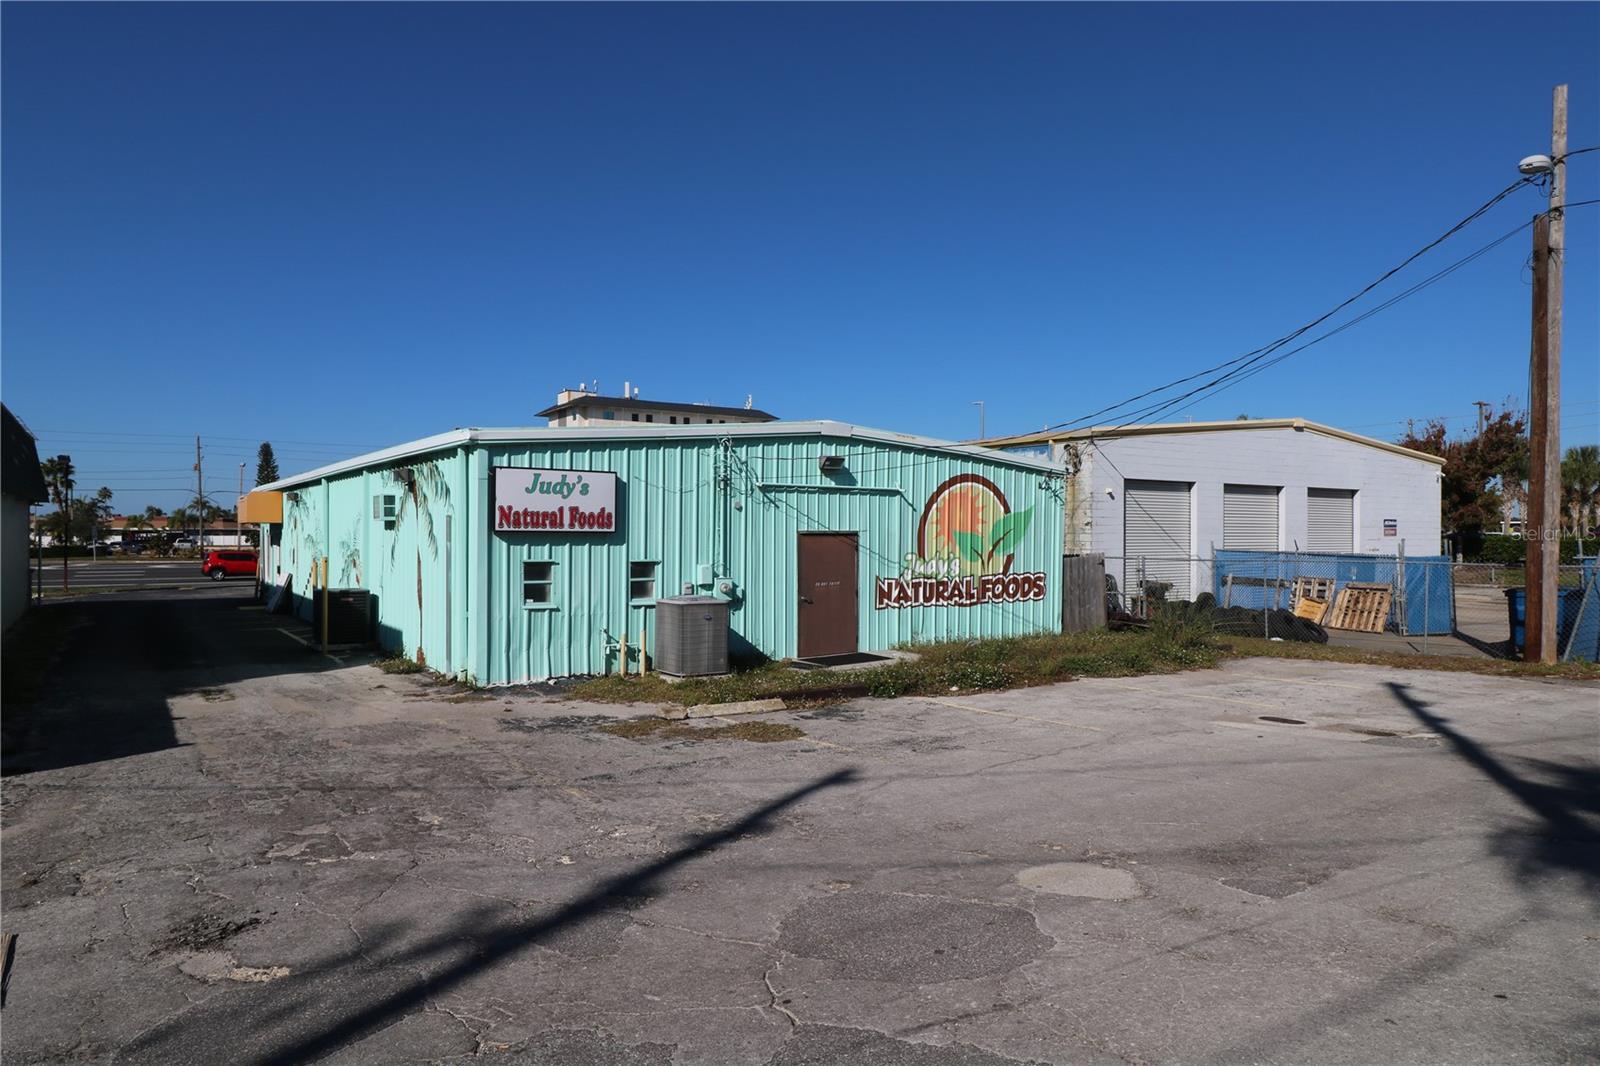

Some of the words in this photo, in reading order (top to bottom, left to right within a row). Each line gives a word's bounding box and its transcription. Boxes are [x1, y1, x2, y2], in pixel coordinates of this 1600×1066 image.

[525, 473, 590, 499] Judy's
[497, 505, 564, 529] Natural
[568, 506, 613, 529] Foods
[902, 551, 960, 581] Judy's
[875, 576, 977, 610] NATURAL
[979, 572, 1047, 602] FOODS
